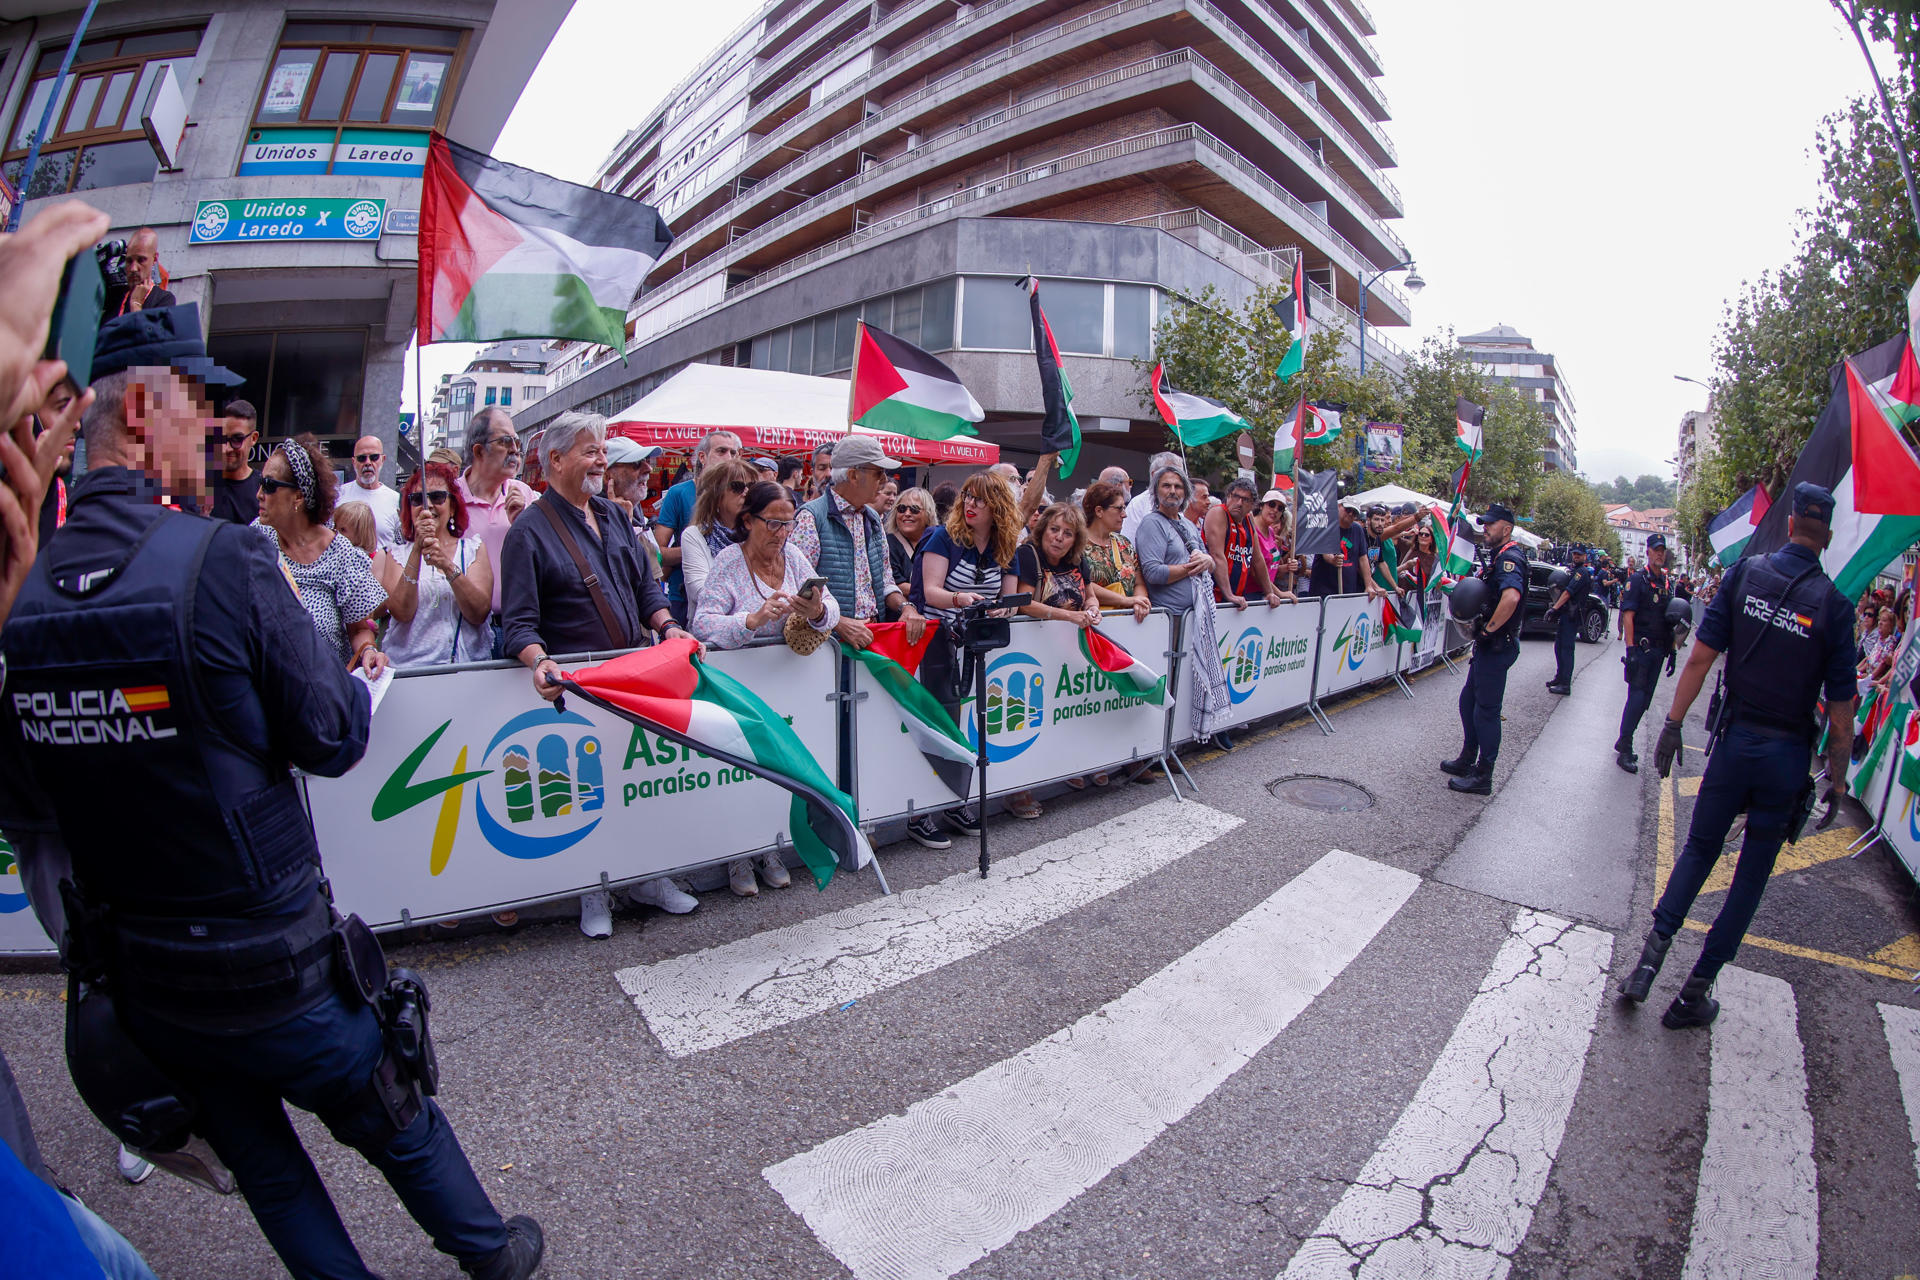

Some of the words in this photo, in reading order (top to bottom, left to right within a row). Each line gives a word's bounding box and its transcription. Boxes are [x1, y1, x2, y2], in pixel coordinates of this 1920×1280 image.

[255, 146, 318, 160] Unidos
[348, 147, 414, 162] Laredo
[202, 206, 226, 218] UNIDOS
[243, 202, 307, 218] Unidos
[351, 204, 377, 216] UNIDOS
[238, 221, 304, 237] Laredo
[755, 426, 798, 447] VENTA
[803, 430, 848, 447] PRODU
[872, 436, 920, 455] FICIAL
[943, 445, 956, 455] LA
[956, 446, 985, 458] VUELTA
[1745, 594, 1798, 623] POLCIA
[1743, 605, 1810, 639] NACONAL
[1266, 635, 1308, 660] Asturias
[1263, 660, 1286, 679] paraíso
[1287, 656, 1306, 672] natural
[1054, 662, 1114, 699] Astu
[1053, 697, 1101, 726] paraíso
[21, 715, 178, 745] NACIONAL
[623, 766, 711, 807] paraíso
